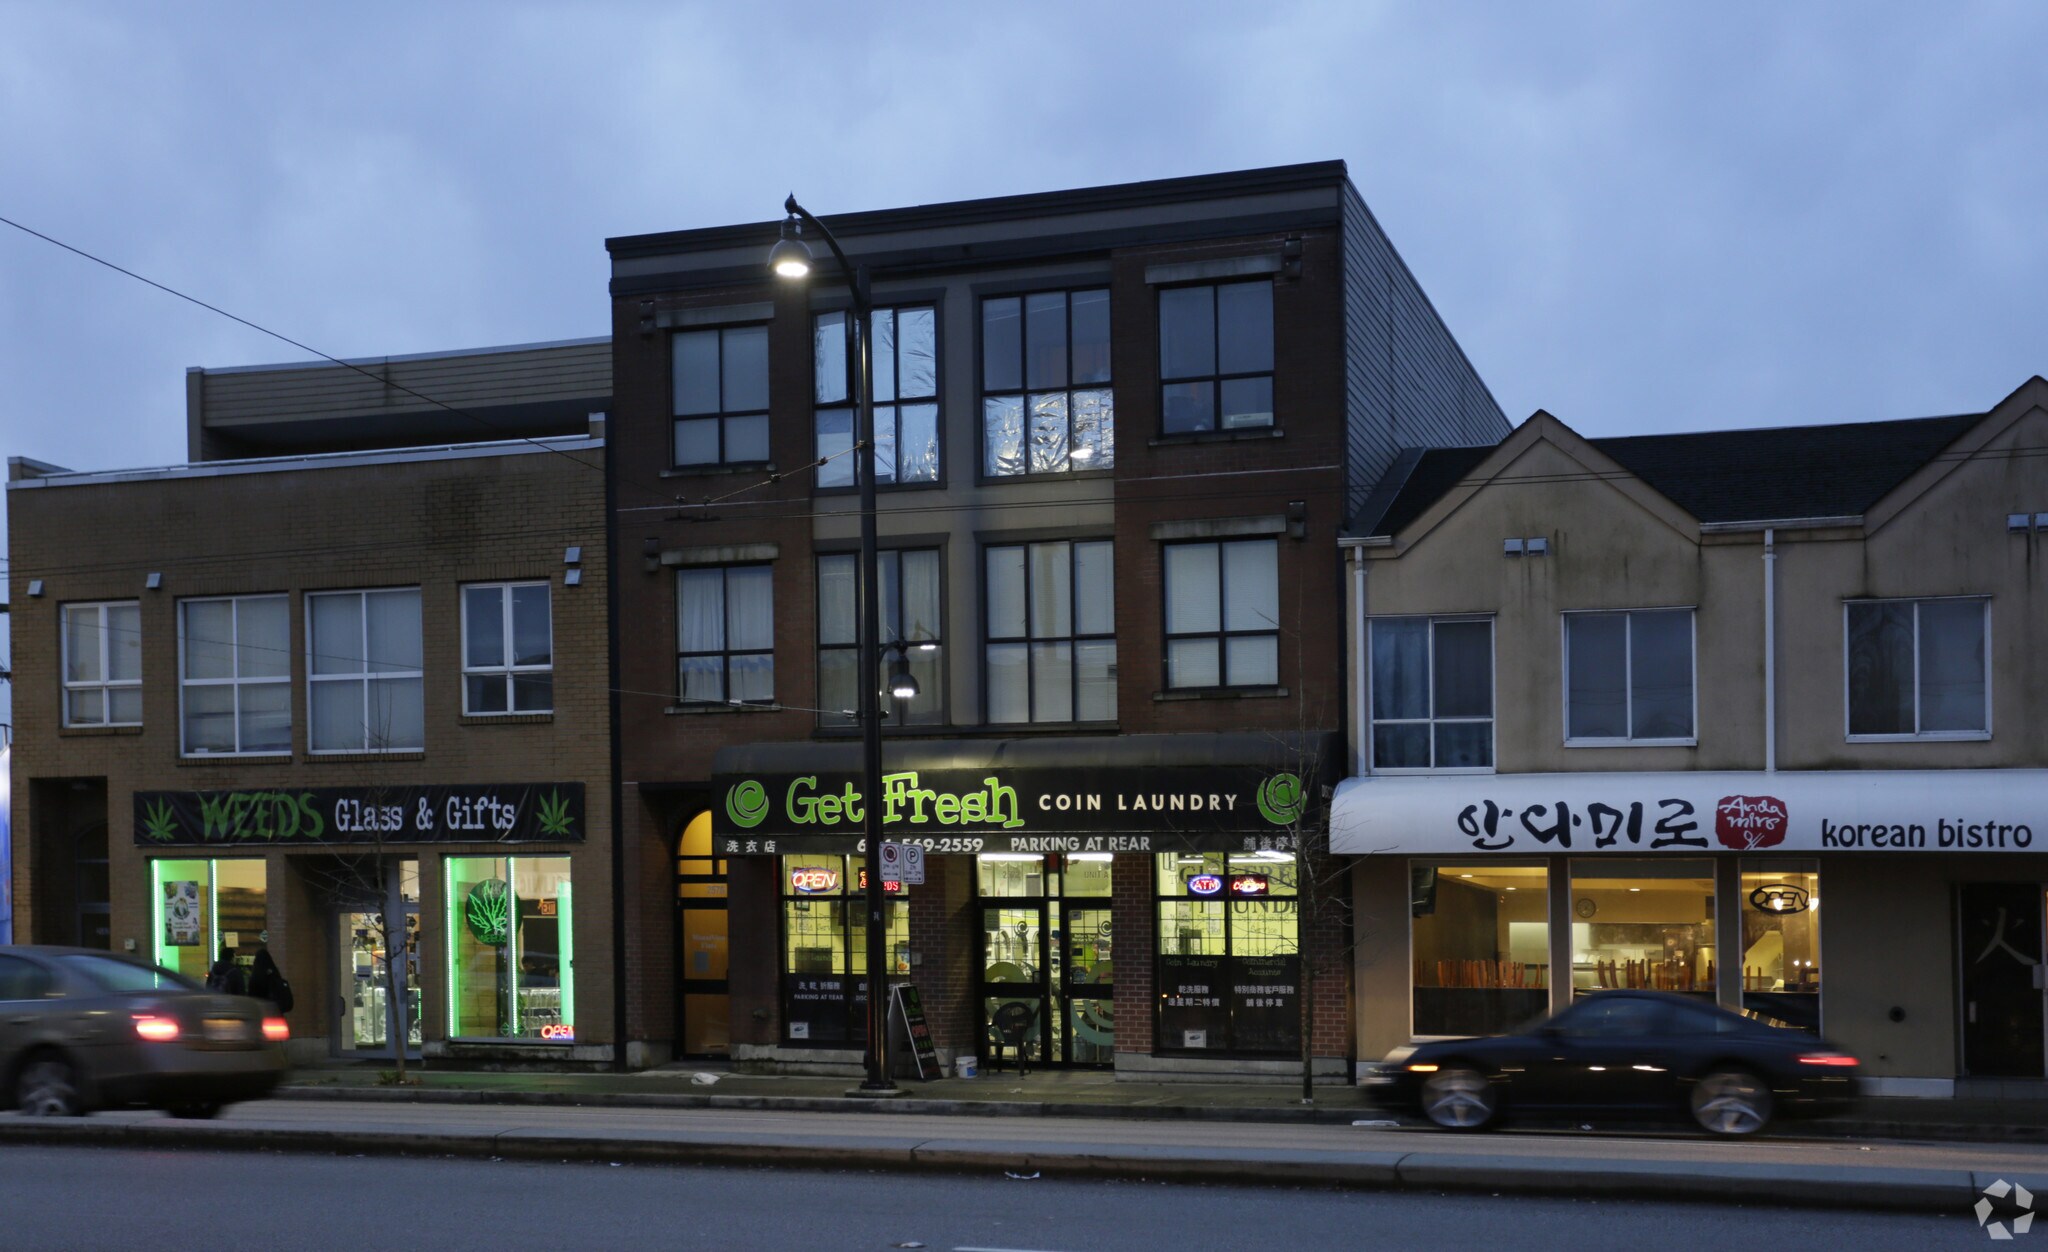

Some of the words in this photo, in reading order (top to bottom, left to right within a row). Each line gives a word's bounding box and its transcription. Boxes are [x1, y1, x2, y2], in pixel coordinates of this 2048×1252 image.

[785, 775, 865, 825] Get
[881, 771, 1025, 829] Fresh
[1039, 794, 1101, 811] COIN
[1117, 794, 1238, 811] LAUNDRY
[1718, 796, 1786, 818] Anda
[197, 792, 324, 841] WEEDS
[335, 798, 403, 832] Glass
[415, 796, 433, 830] &
[446, 795, 516, 830] Gifts
[1457, 798, 1709, 850] 안다미로
[1821, 818, 1926, 848] korean
[1938, 818, 2033, 848] bistro
[726, 839, 776, 853] 洗衣店
[1010, 836, 1080, 852] PARKING
[1084, 836, 1103, 851] AT
[1108, 836, 1151, 851] REAR
[792, 873, 837, 887] OPEN
[1193, 880, 1219, 890] ATM
[794, 993, 819, 1001] PARKING
